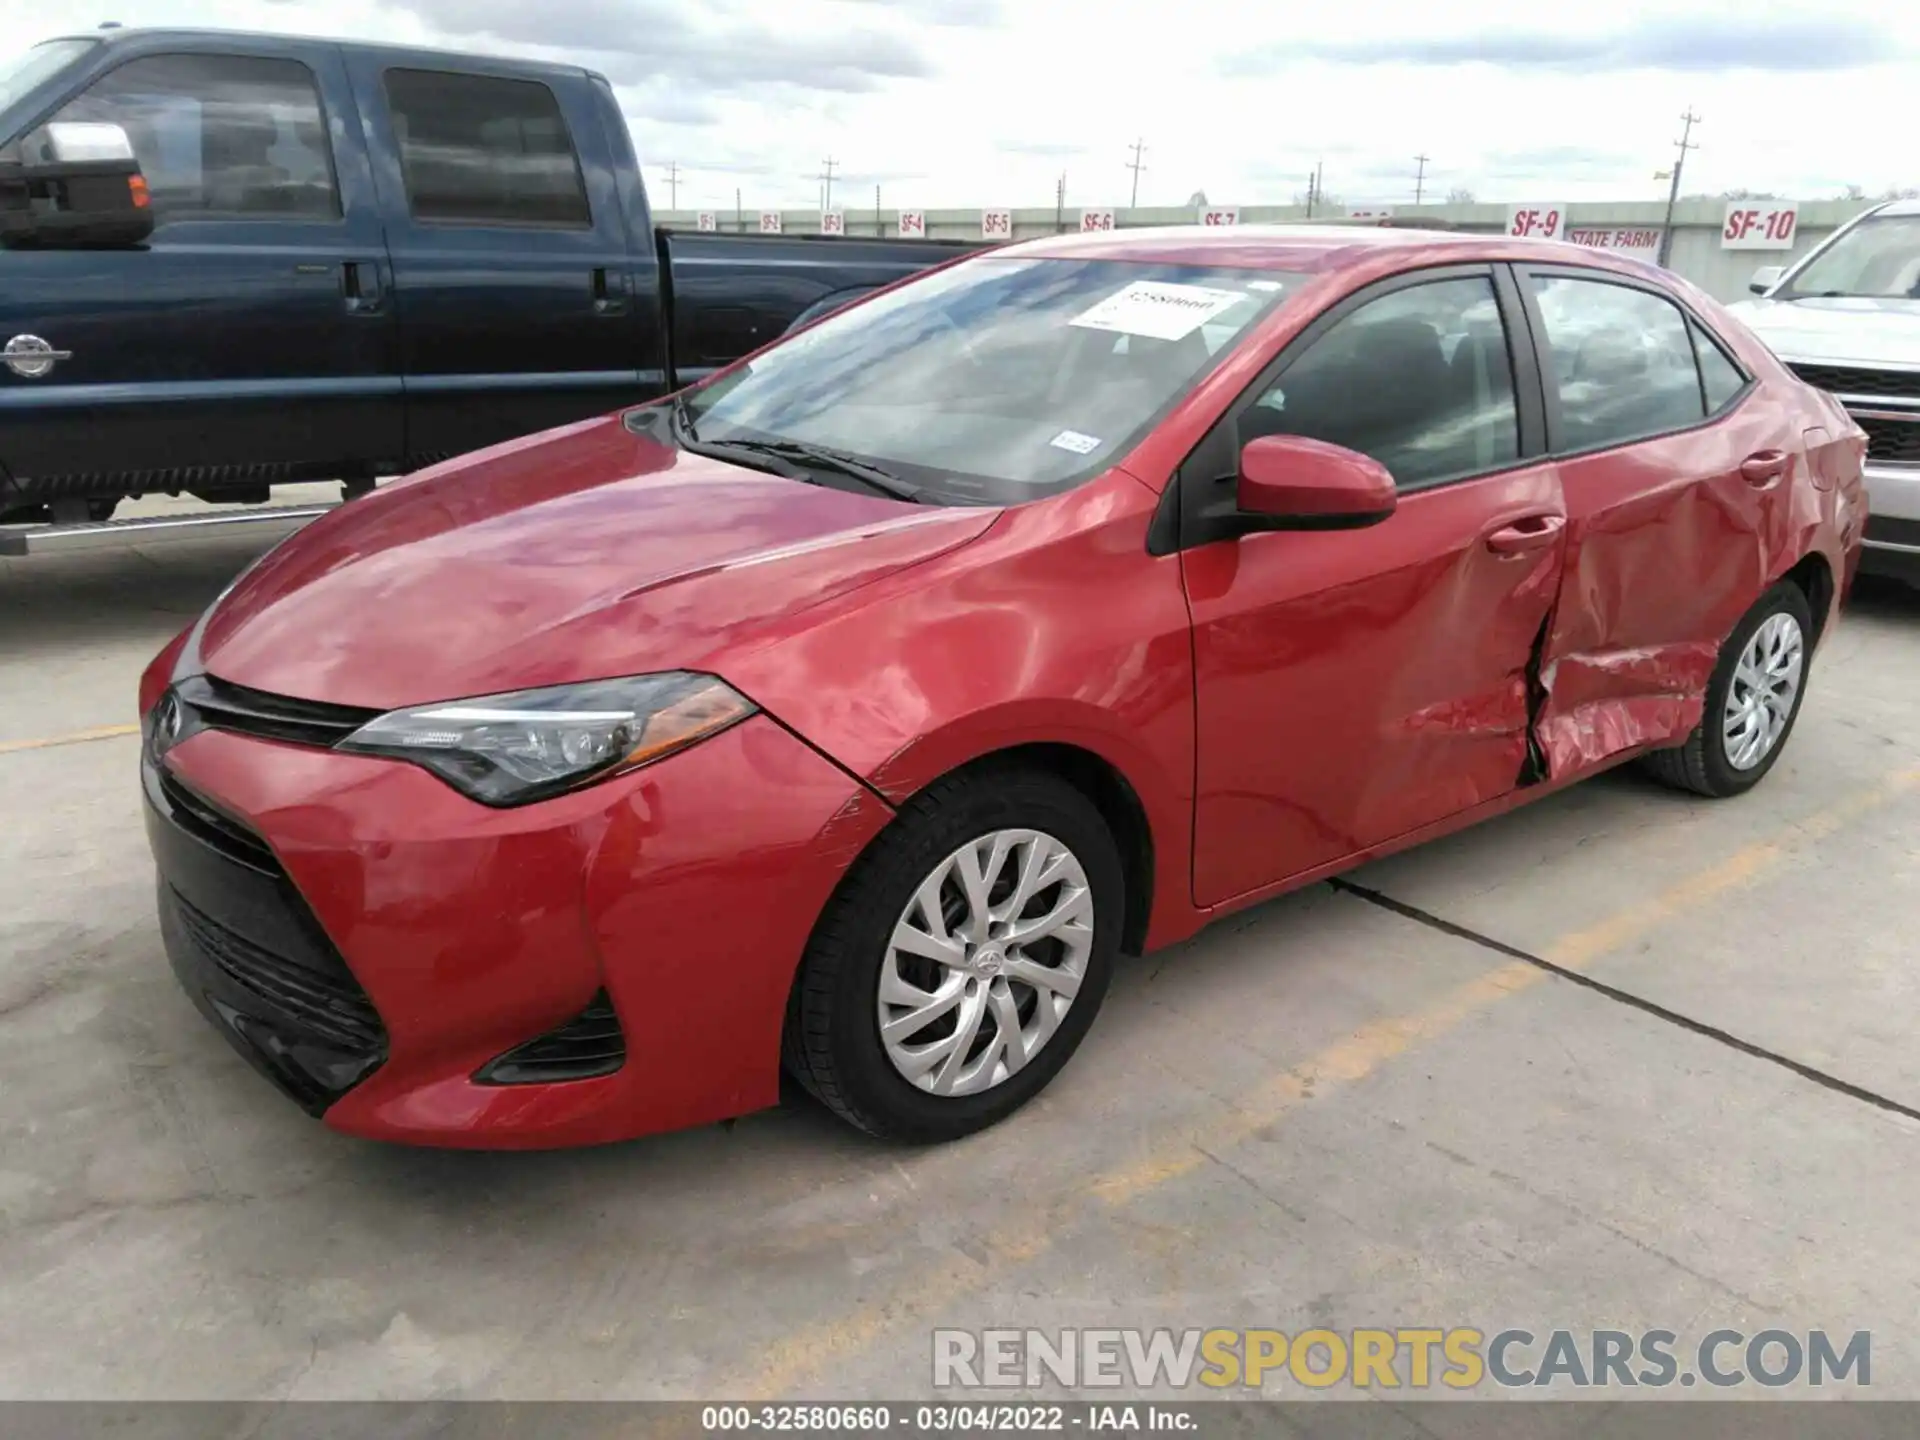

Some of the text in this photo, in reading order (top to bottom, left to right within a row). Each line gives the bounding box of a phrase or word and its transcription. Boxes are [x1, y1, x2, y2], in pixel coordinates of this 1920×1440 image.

[901, 214, 921, 232] SF-4
[985, 213, 1008, 232] SF-5
[1083, 213, 1111, 231] SF-6
[1511, 210, 1559, 237] SF-9
[1724, 209, 1796, 240] SF-10
[1571, 230, 1659, 249] STATE FARM
